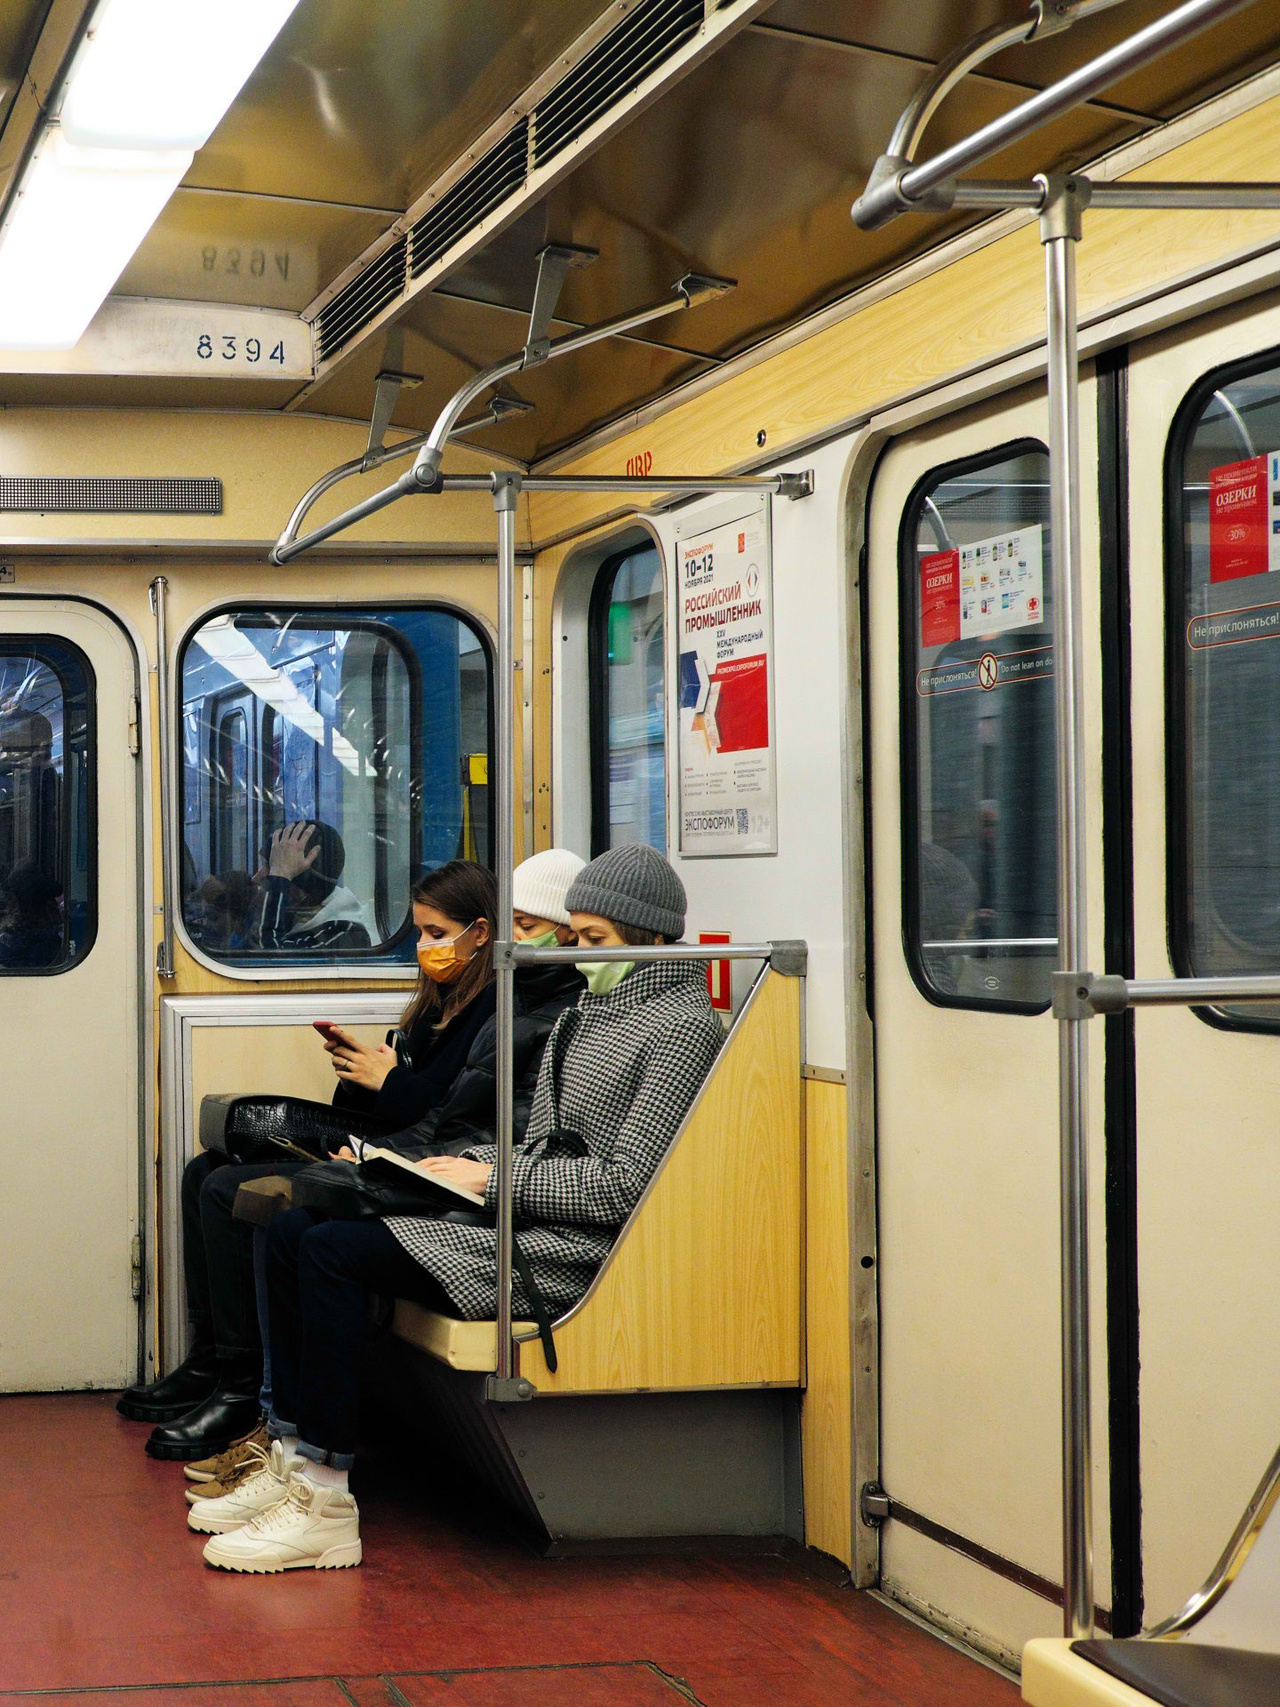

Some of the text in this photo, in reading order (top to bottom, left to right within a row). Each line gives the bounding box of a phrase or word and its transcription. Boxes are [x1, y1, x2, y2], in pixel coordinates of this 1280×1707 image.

[197, 334, 285, 365] 8394
[1216, 485, 1257, 507] ОЗЕРКИ
[926, 572, 953, 589] ОЗЕРКИ
[685, 581, 741, 614] РОССИЙСКИЙ
[685, 599, 762, 634] ПРОМЫШЛЕННИК
[1194, 612, 1280, 639] Не прислоняться!
[716, 629, 763, 648] МЕЖДУНАРОДНЫЙ
[717, 648, 734, 659] ФОРУМ
[1010, 663, 1020, 671] not
[1021, 661, 1034, 670] lean
[1044, 658, 1053, 666] do
[921, 669, 977, 688] Не прислоняться!
[685, 816, 735, 831] ЭКСПОФОРУМ
